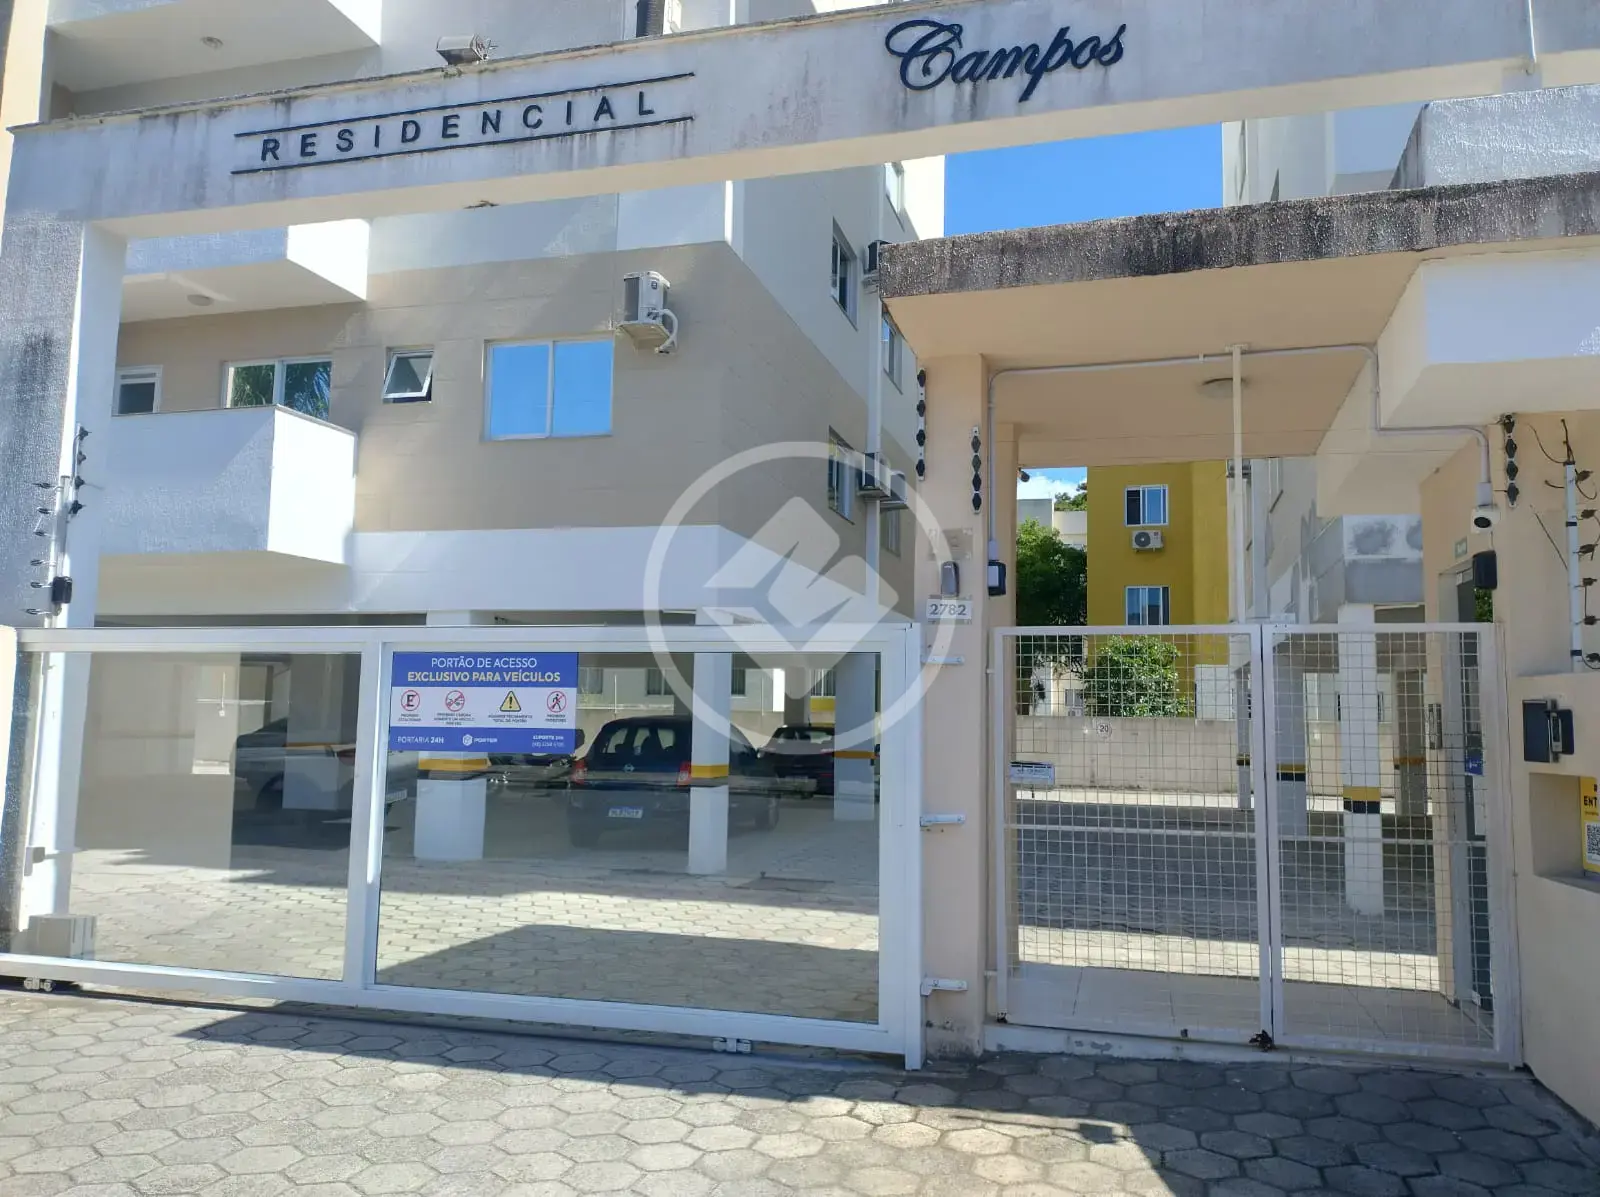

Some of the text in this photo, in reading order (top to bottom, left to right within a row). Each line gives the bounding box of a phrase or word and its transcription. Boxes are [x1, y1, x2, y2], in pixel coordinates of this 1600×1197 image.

[884, 19, 1127, 103] Campos
[260, 91, 655, 161] RESIDENCIAL
[929, 603, 967, 616] 2782
[431, 656, 538, 668] PORTÃO DE ACESSO
[407, 670, 561, 682] EXCLUSIVO PARA VEÍCULOS
[397, 736, 445, 744] PORTARIA 24H
